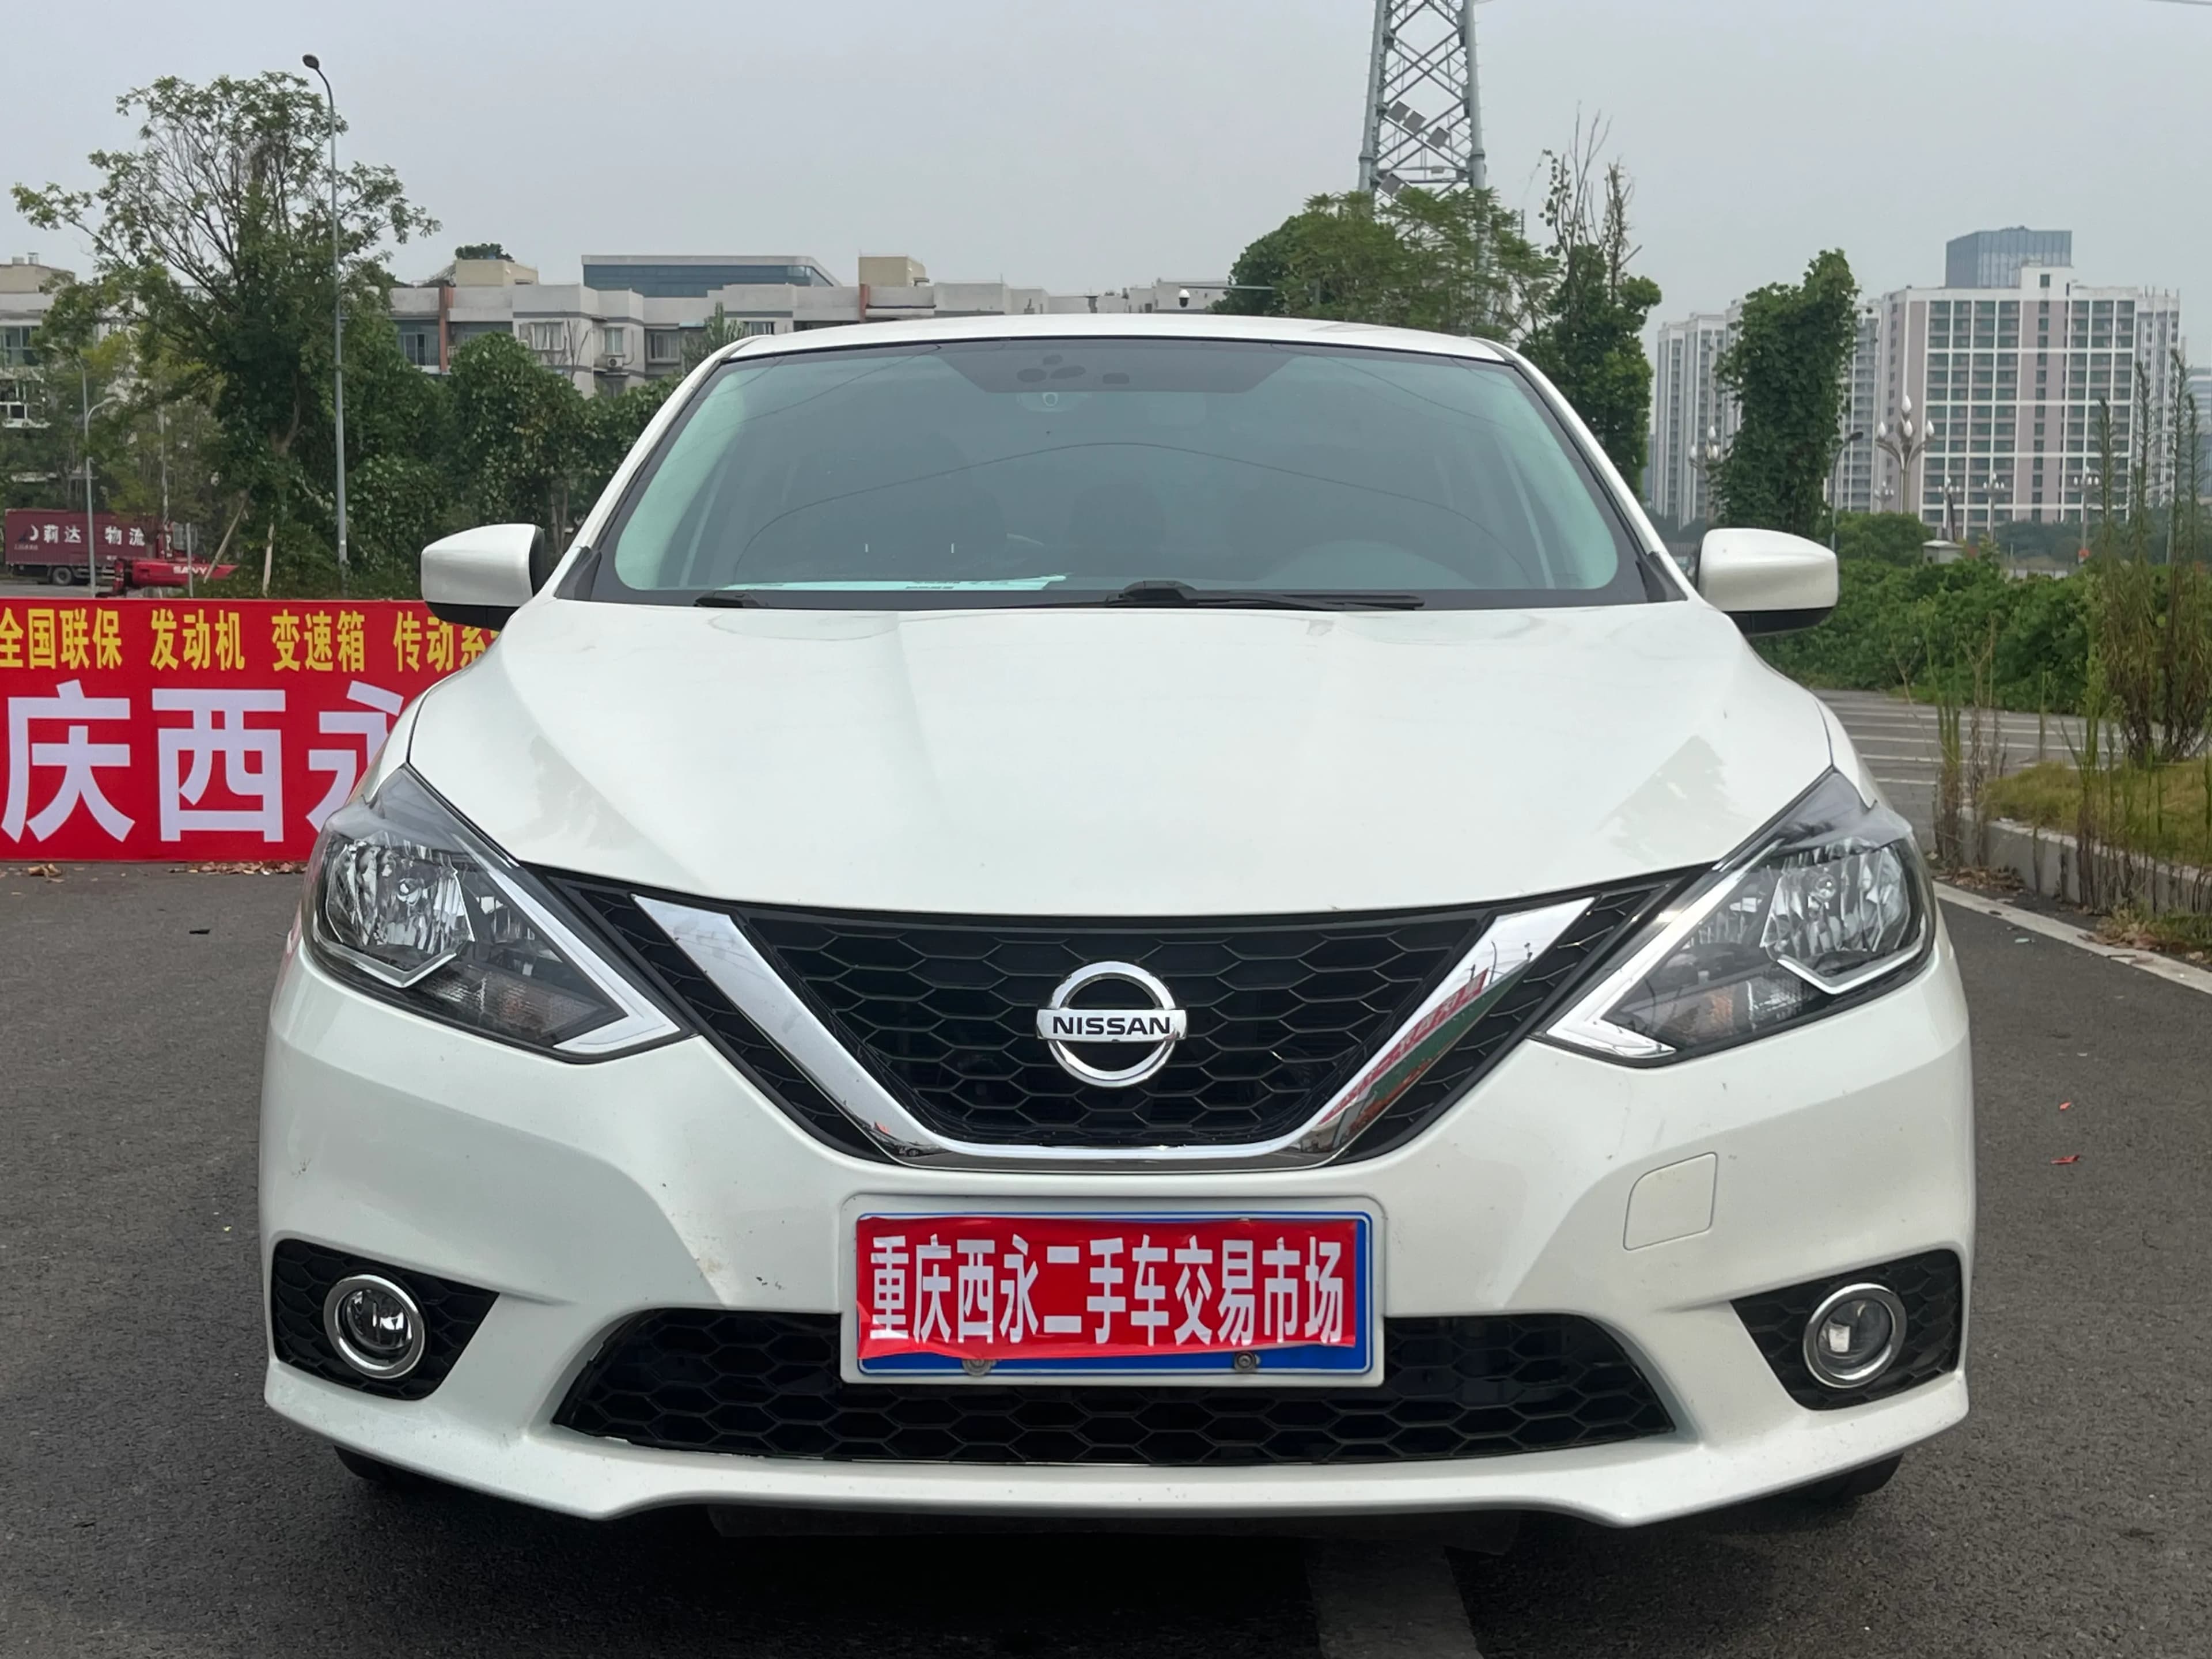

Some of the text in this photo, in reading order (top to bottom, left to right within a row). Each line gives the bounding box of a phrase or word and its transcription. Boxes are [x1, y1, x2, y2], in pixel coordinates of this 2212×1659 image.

[105, 526, 145, 546] 物流
[0, 607, 501, 673] 全国联保 发动机 变速箱 传动系
[1053, 1016, 1170, 1035] NISSAN
[869, 1233, 1343, 1346] 重庆西永二手车交易市场
